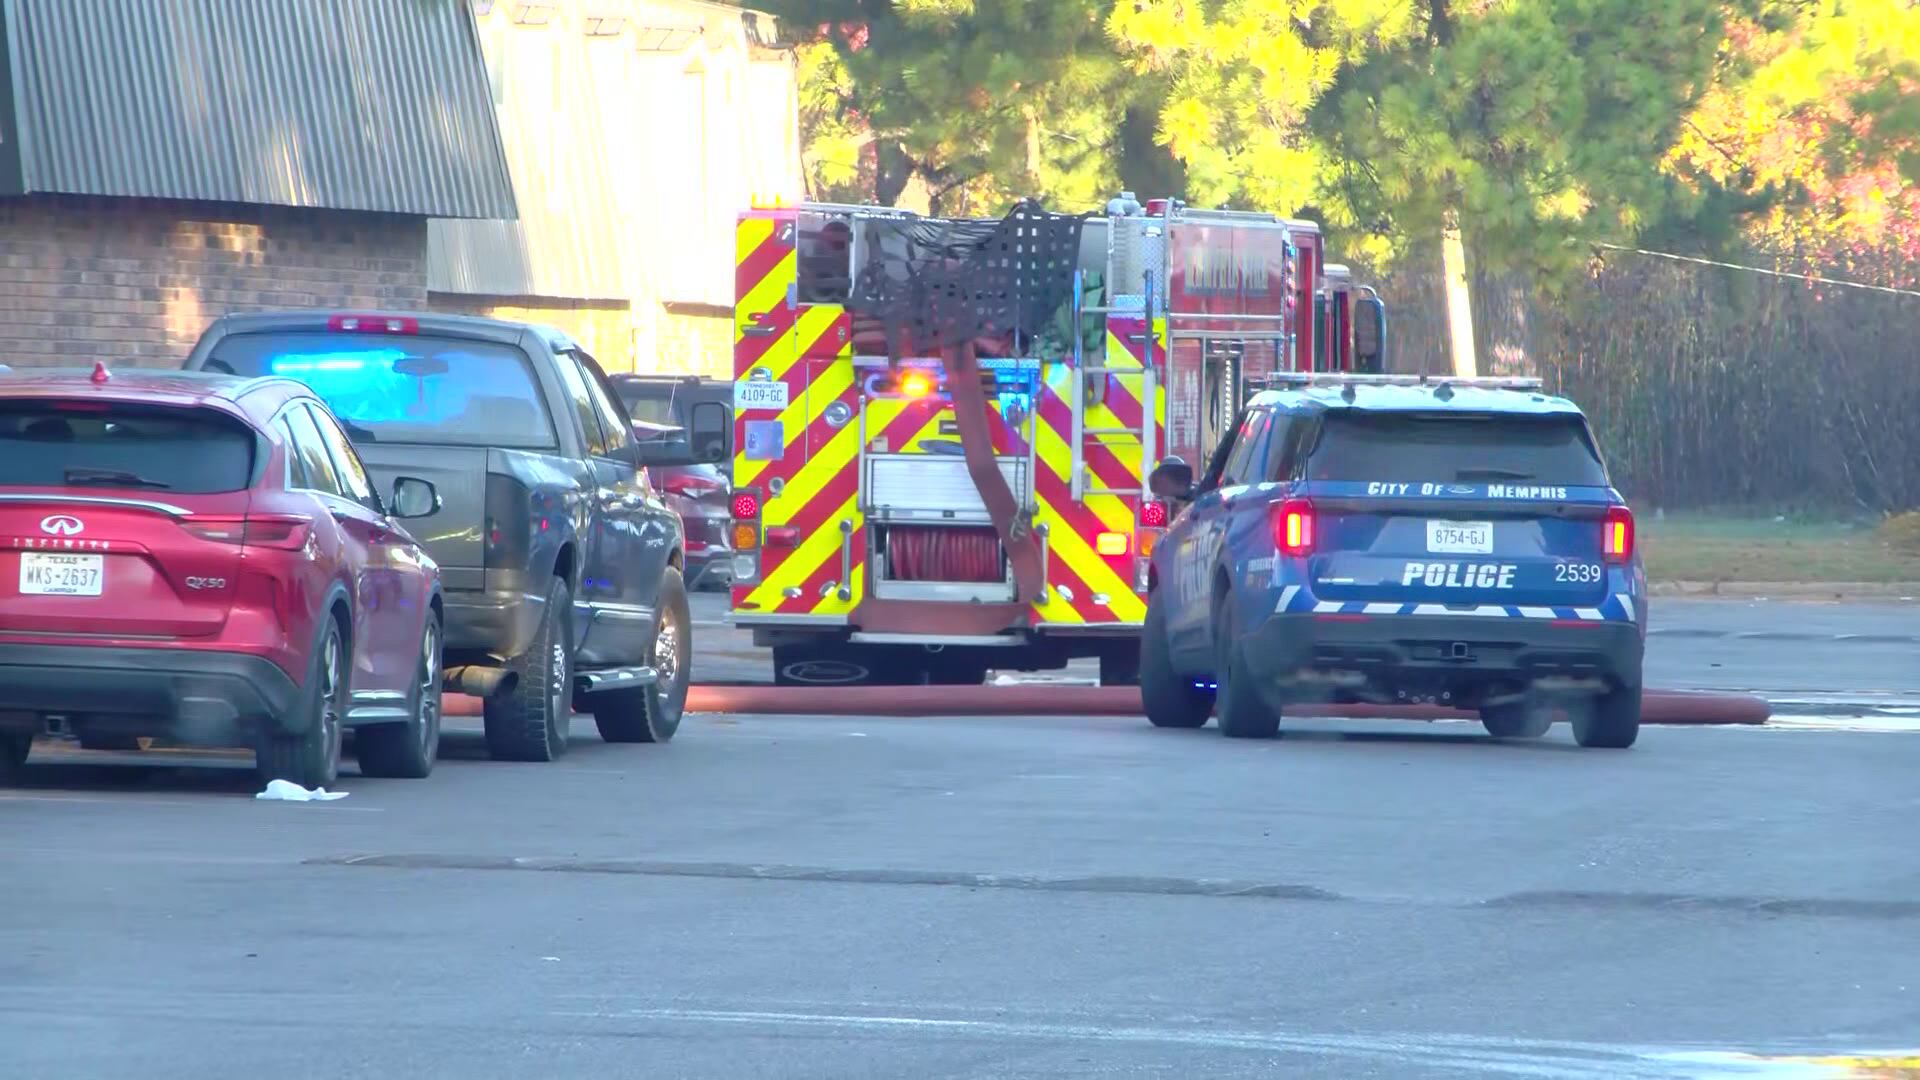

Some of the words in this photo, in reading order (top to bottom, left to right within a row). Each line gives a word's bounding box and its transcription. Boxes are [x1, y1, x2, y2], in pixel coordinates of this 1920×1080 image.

[741, 389, 783, 402] 4109-GC
[1367, 482, 1409, 496] CITY
[1421, 483, 1443, 496] OF
[1487, 484, 1567, 499] MEMPHIS
[1435, 529, 1485, 545] 8754-GJ
[27, 566, 98, 587] WKS-2637
[1401, 562, 1517, 589] POLICE
[1555, 564, 1601, 583] 2539
[185, 576, 226, 589] QX50
